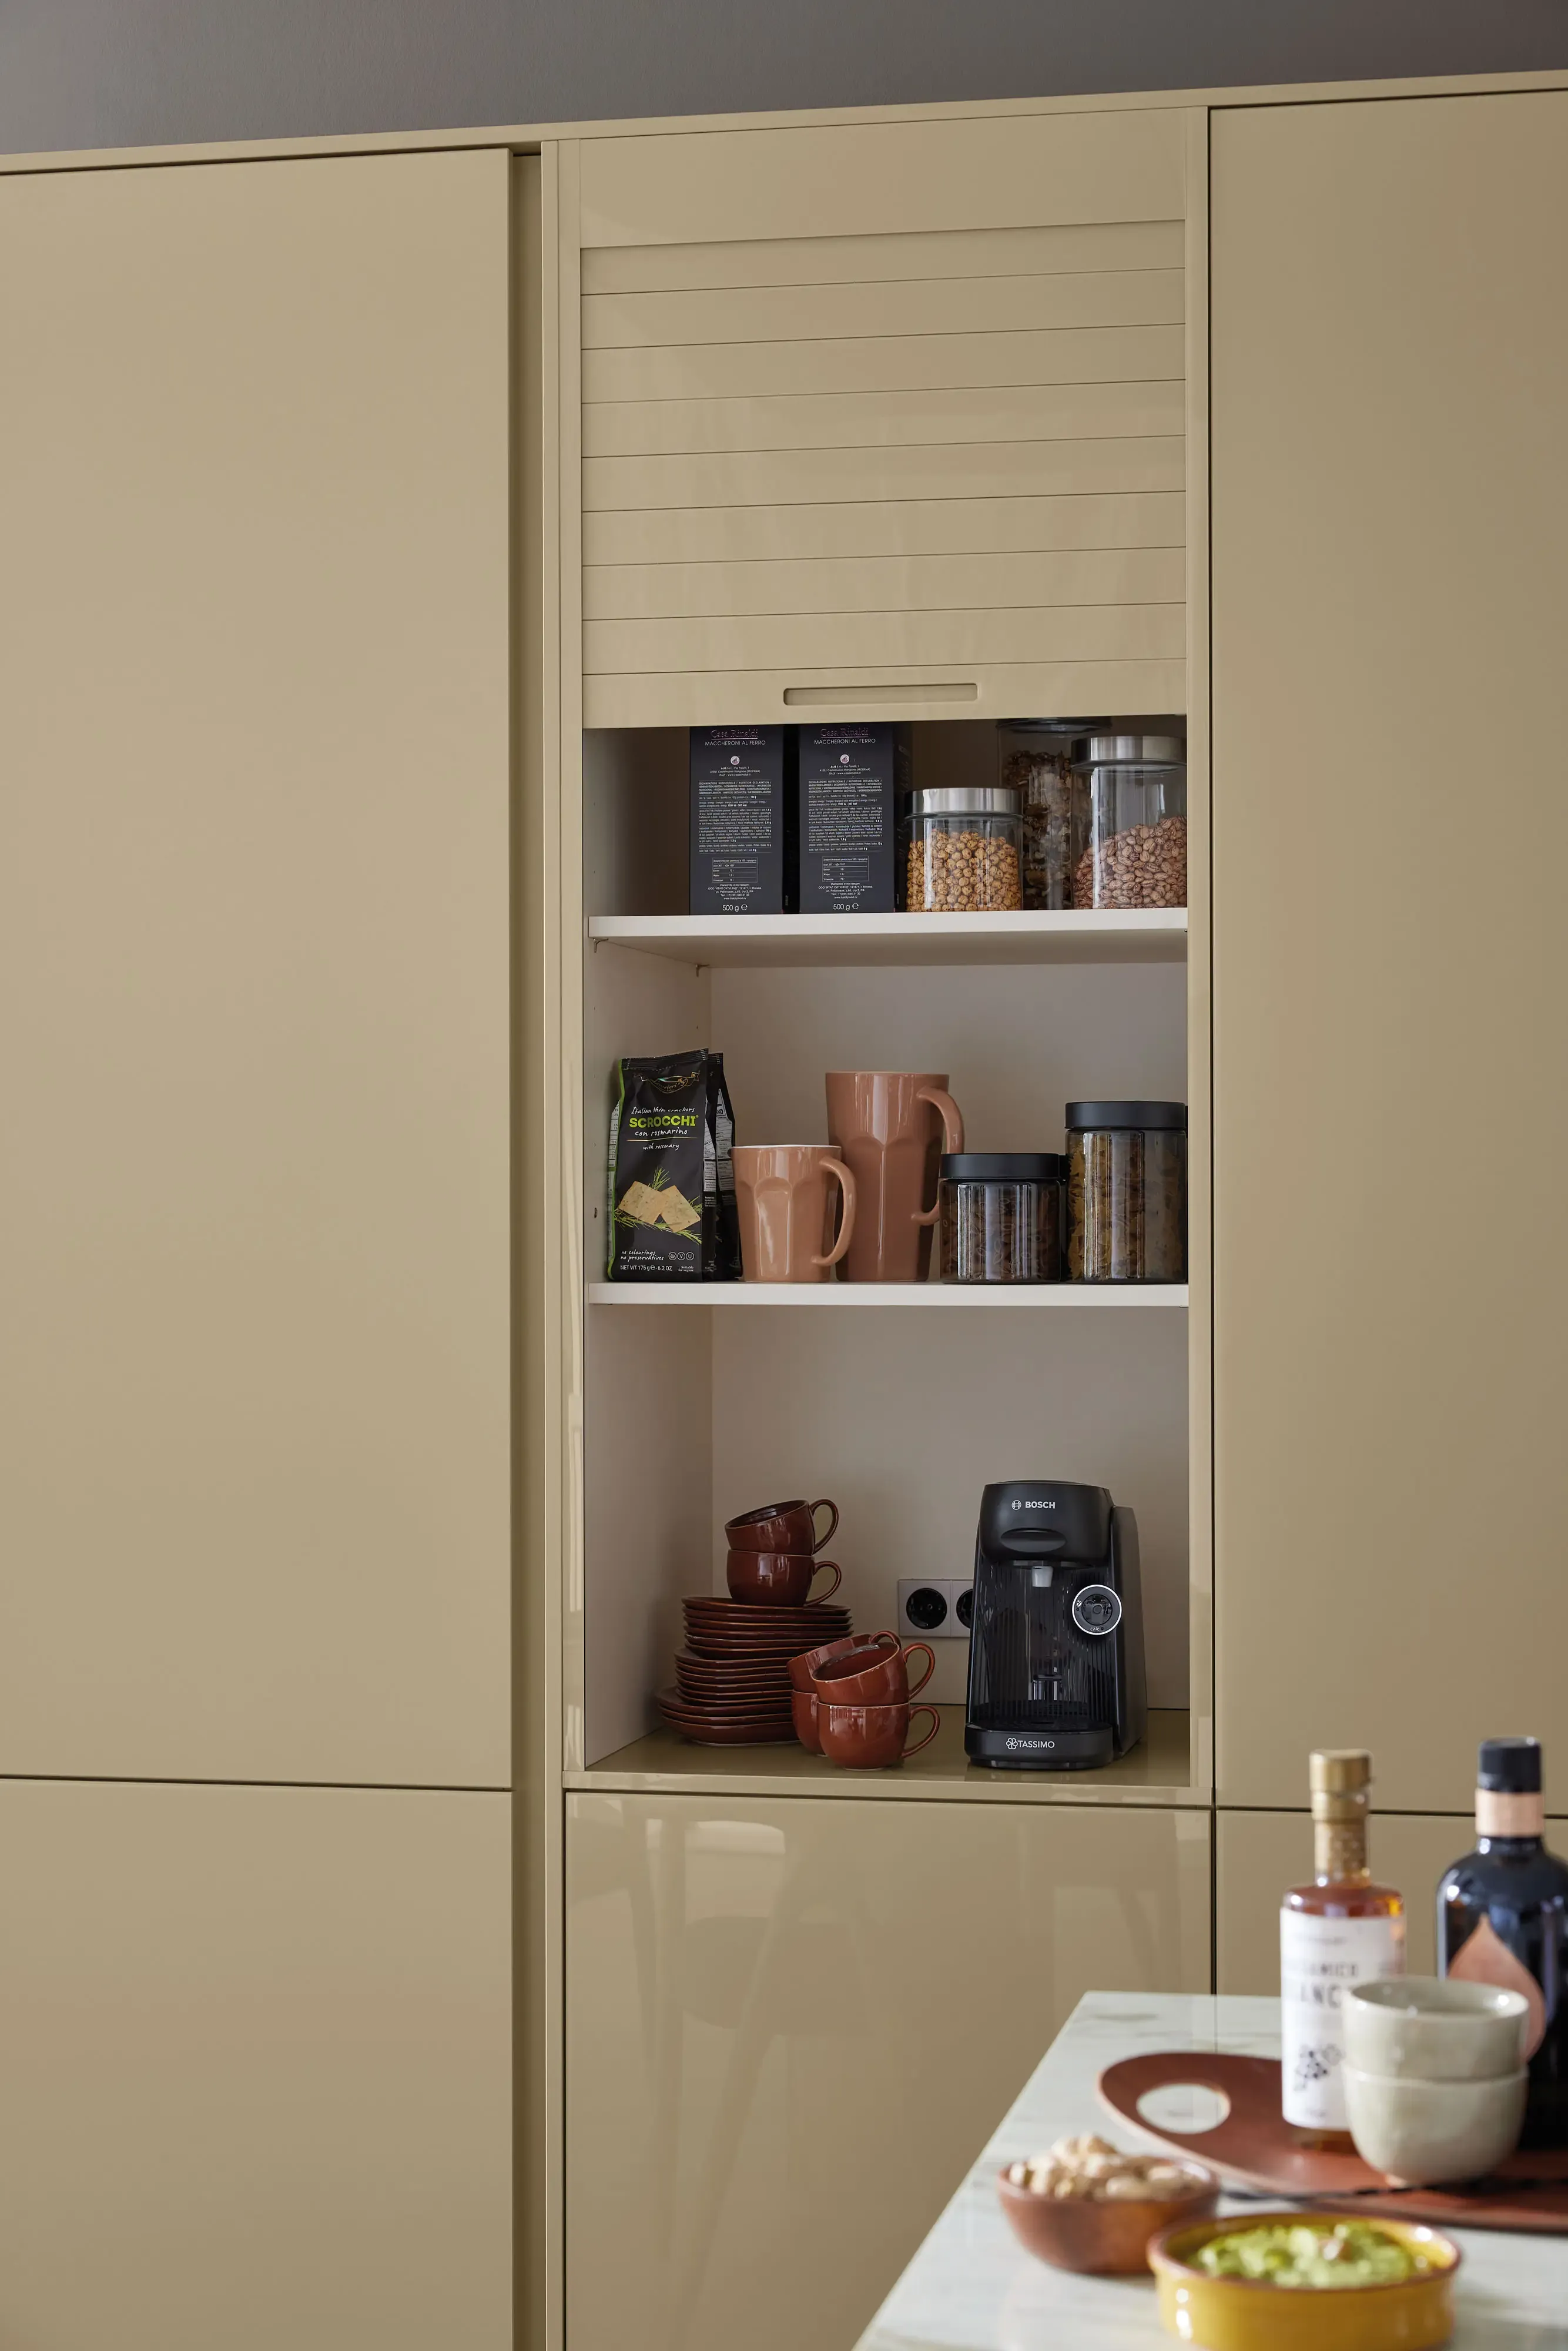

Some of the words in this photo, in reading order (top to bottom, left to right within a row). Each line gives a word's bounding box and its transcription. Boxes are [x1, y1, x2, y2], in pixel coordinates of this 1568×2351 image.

[631, 1106, 652, 1114] Italian
[629, 1115, 696, 1128] SCROCCHI
[651, 1127, 688, 1136] rosmarino
